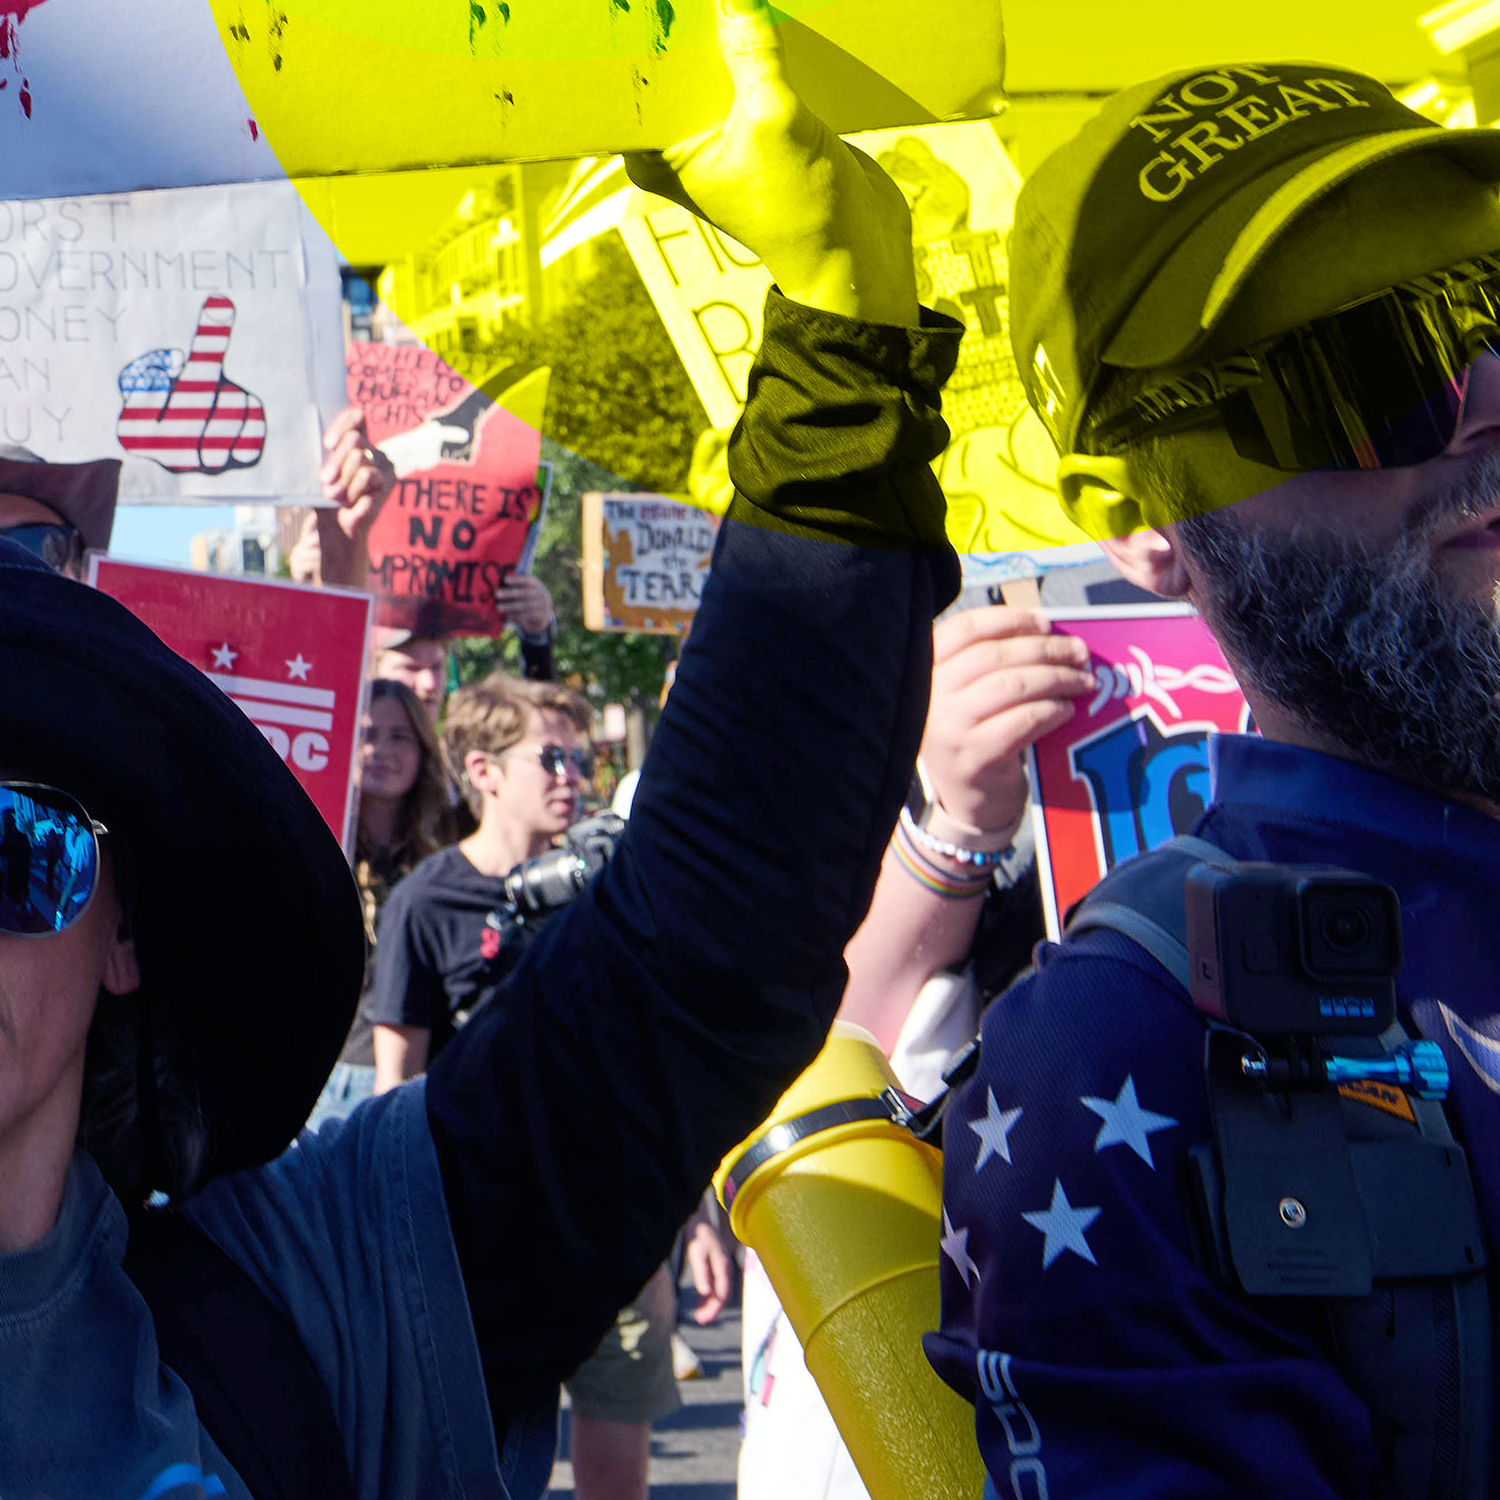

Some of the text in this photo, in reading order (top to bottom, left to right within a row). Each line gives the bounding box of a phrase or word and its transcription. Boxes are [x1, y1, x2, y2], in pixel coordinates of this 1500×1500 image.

[1129, 64, 1281, 143] NOT
[1139, 78, 1371, 202] GREAT
[399, 478, 486, 514] THERE
[409, 516, 476, 550] NO
